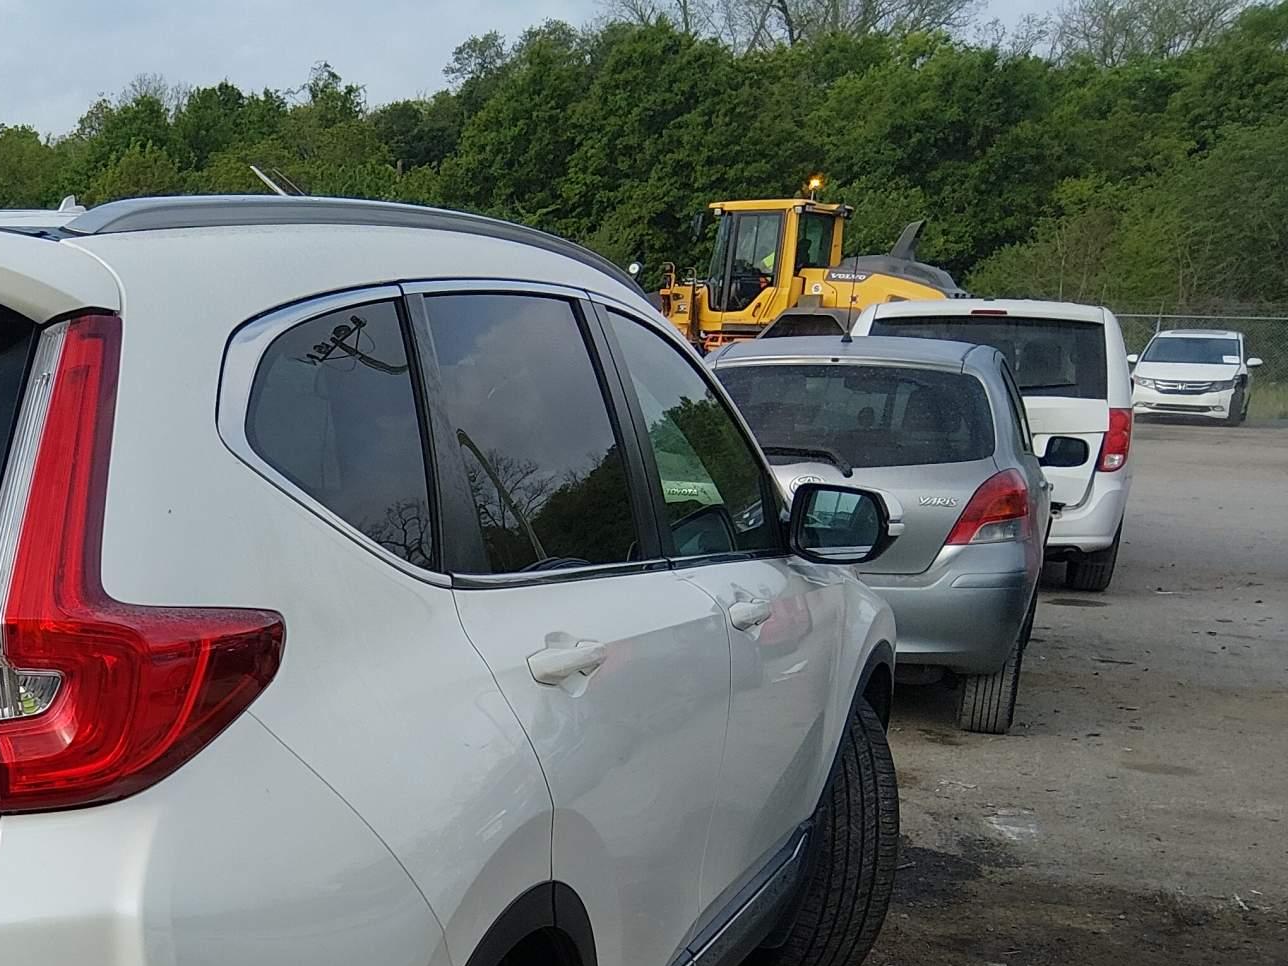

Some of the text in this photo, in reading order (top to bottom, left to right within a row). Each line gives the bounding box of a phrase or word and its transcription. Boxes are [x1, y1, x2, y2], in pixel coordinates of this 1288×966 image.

[831, 272, 867, 280] VOLVO
[667, 488, 699, 496] TOYOTA
[919, 496, 958, 507] YARIS
